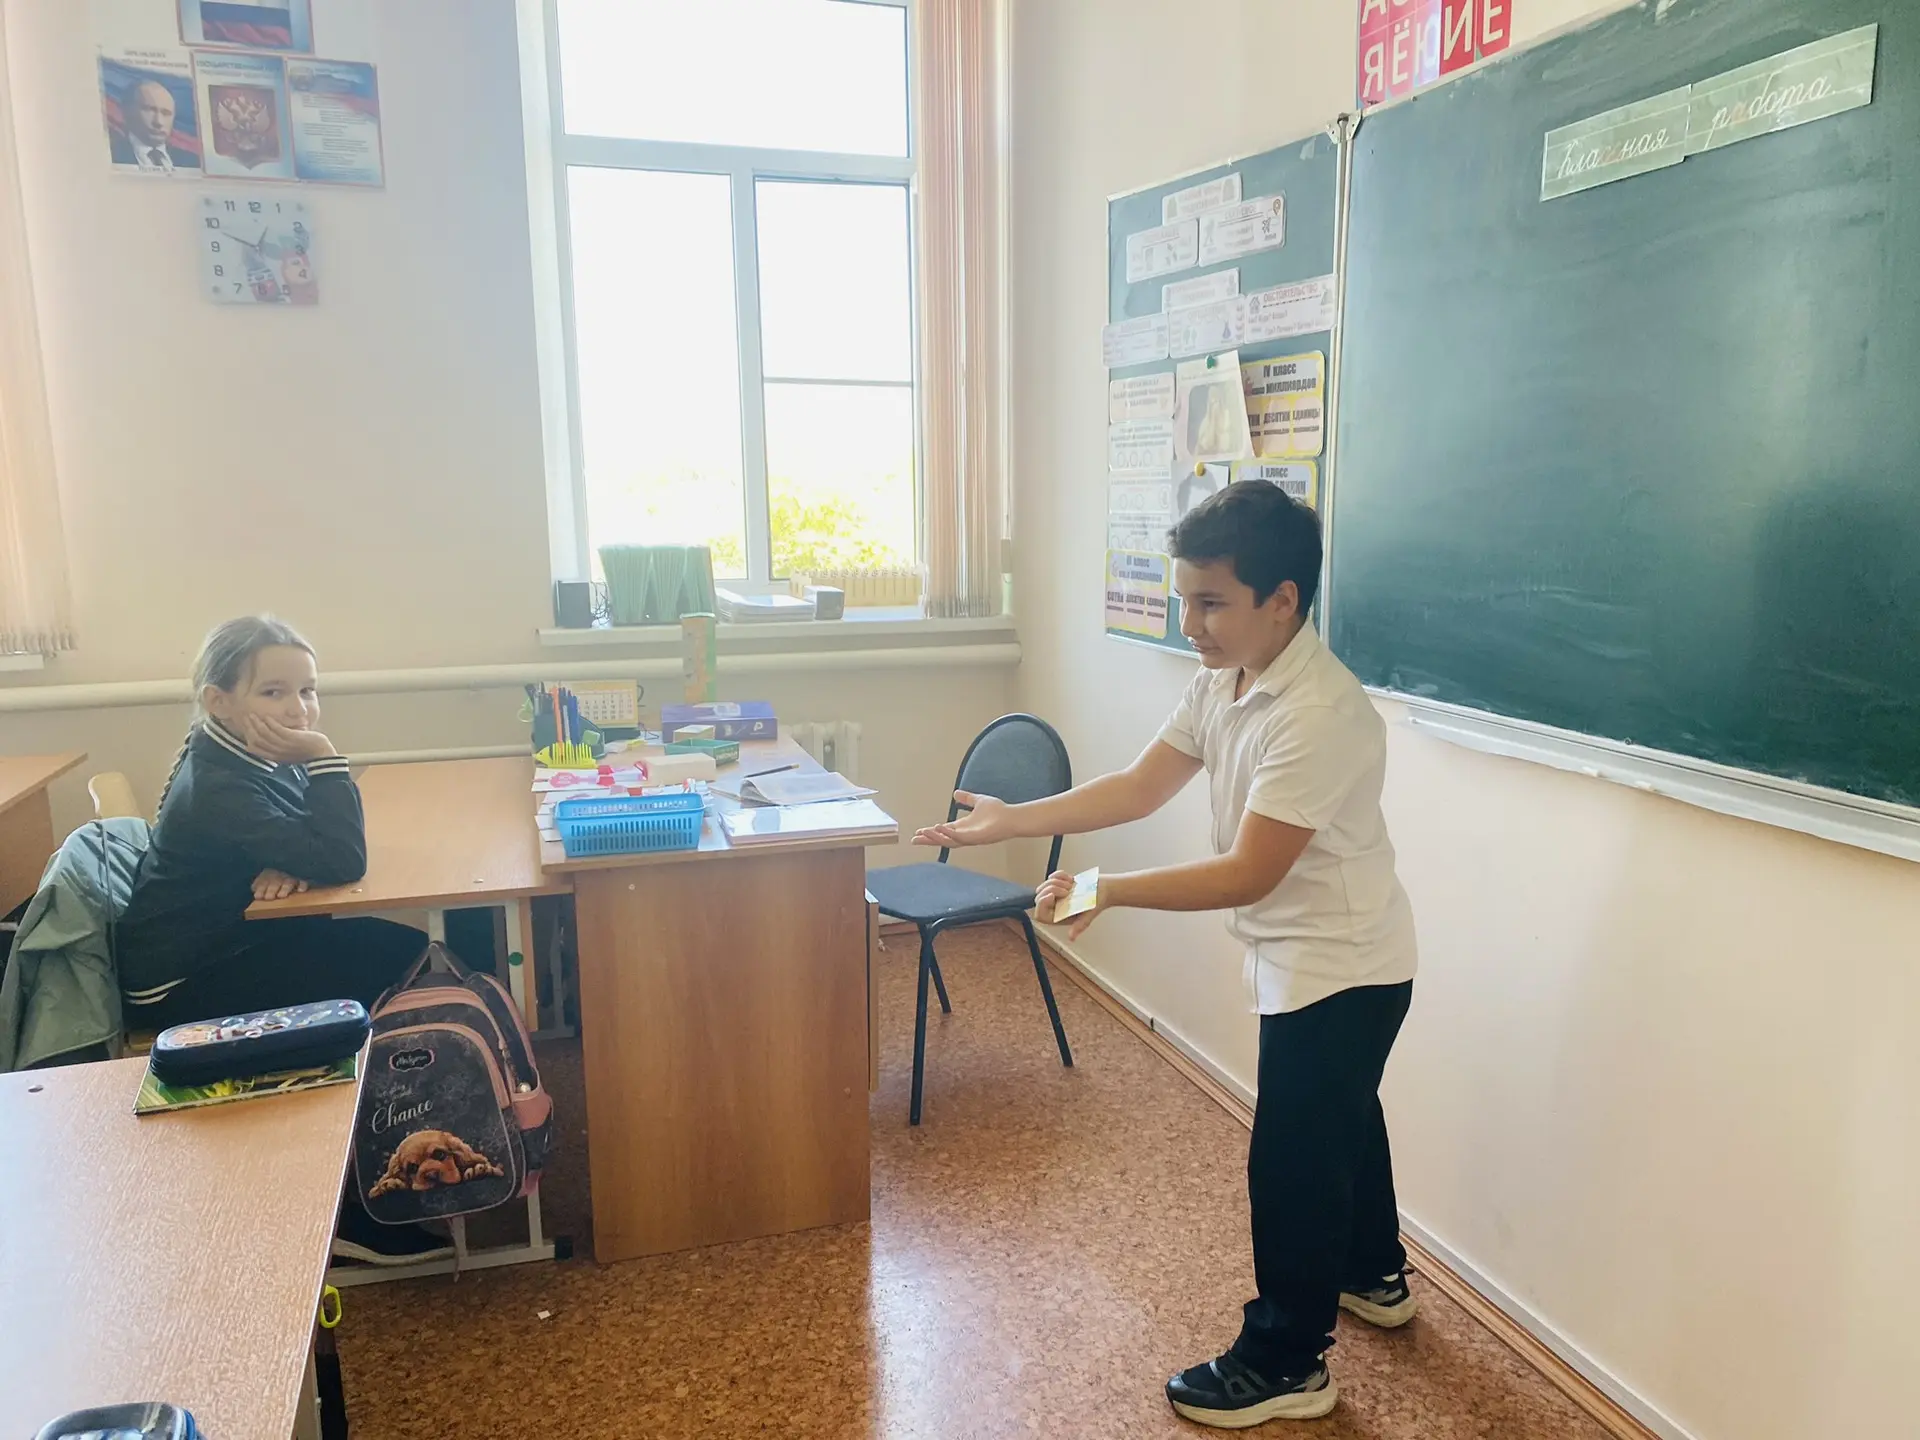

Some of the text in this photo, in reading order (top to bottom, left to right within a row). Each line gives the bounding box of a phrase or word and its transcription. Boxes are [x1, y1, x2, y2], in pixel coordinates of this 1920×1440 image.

[224, 200, 236, 212] 11
[248, 201, 262, 214] 12
[275, 202, 282, 214] 1
[204, 217, 221, 230] 10
[210, 240, 221, 254] 9
[213, 264, 224, 278] 8
[232, 282, 243, 295] 7
[371, 1099, 435, 1135] Chance
